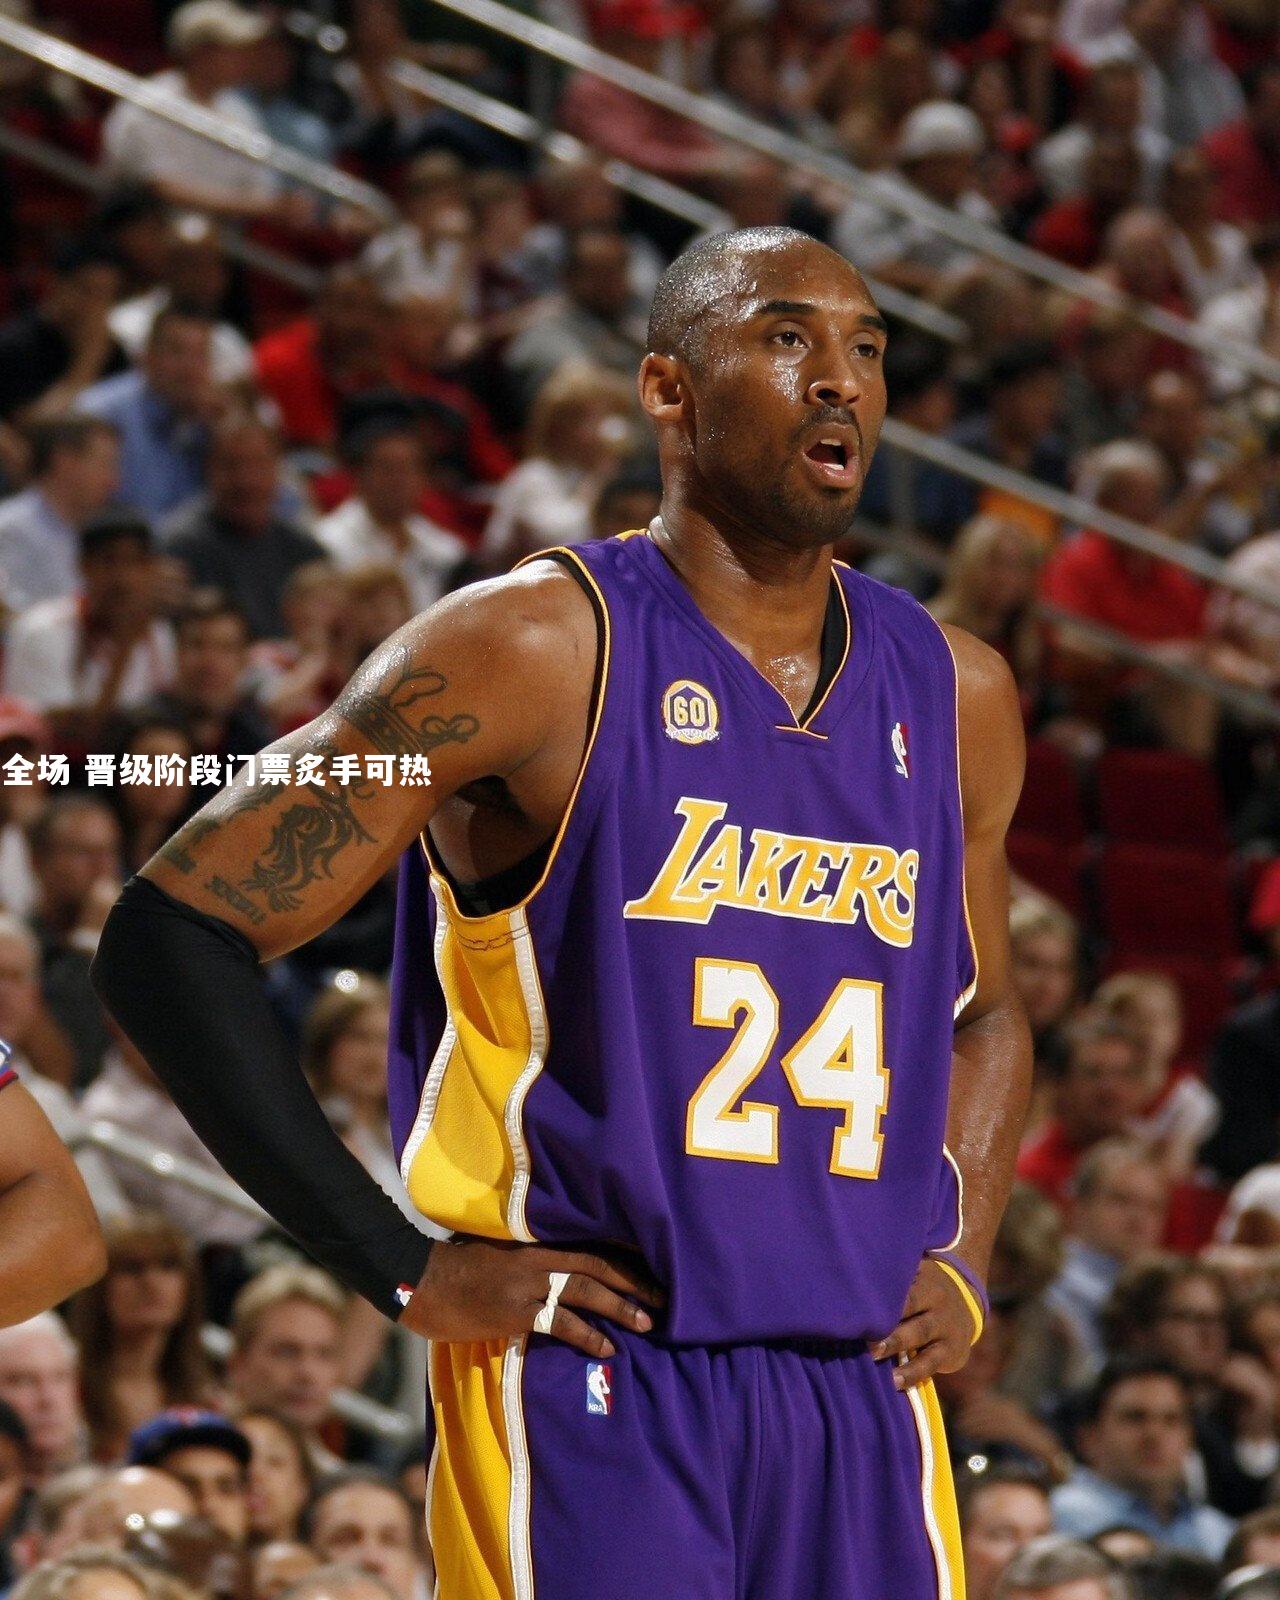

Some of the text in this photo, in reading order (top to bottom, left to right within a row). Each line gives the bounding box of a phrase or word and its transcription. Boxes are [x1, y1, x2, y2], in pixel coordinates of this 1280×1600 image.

[673, 695, 706, 727] 60
[623, 796, 919, 948] LAKERS
[685, 957, 891, 1180] 24
